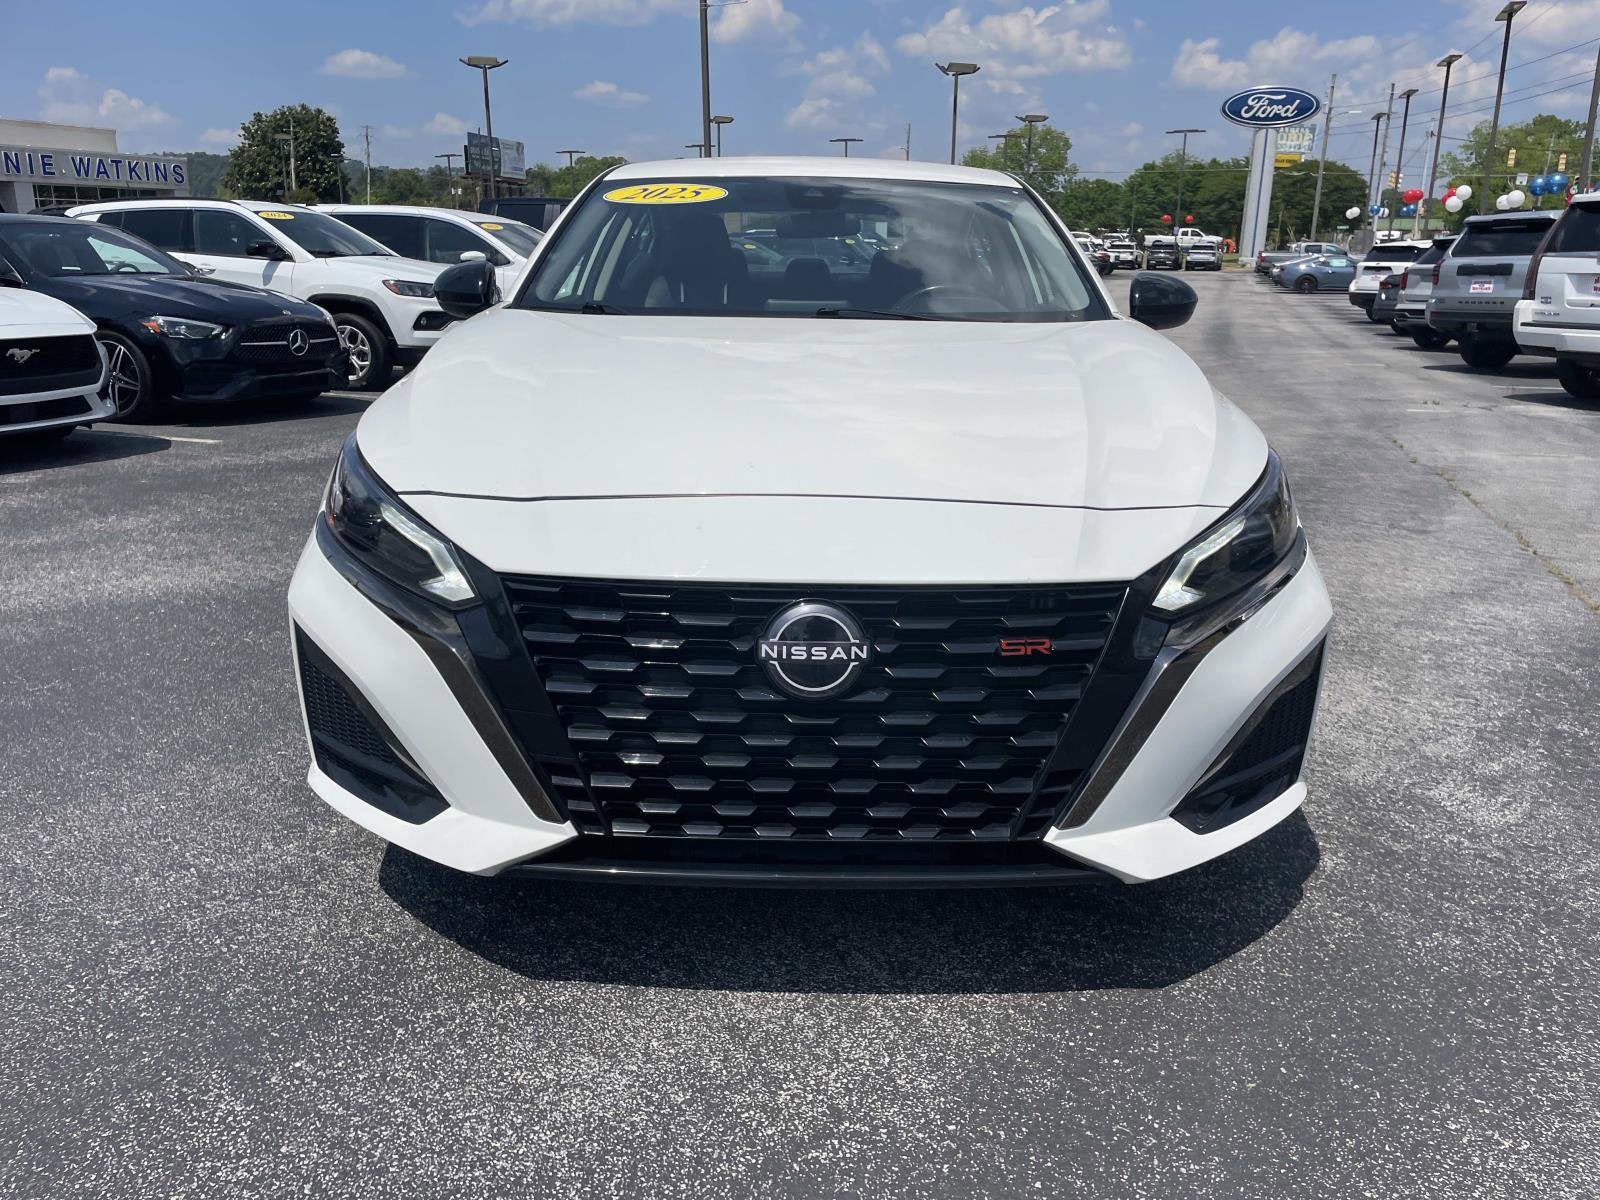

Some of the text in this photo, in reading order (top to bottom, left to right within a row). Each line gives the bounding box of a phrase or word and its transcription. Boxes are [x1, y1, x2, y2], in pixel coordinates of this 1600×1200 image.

[1241, 94, 1300, 118] Ford
[70, 156, 185, 184] WATKINS
[621, 187, 711, 200] 2025
[760, 643, 868, 661] NISSAN
[1000, 638, 1051, 656] SR
